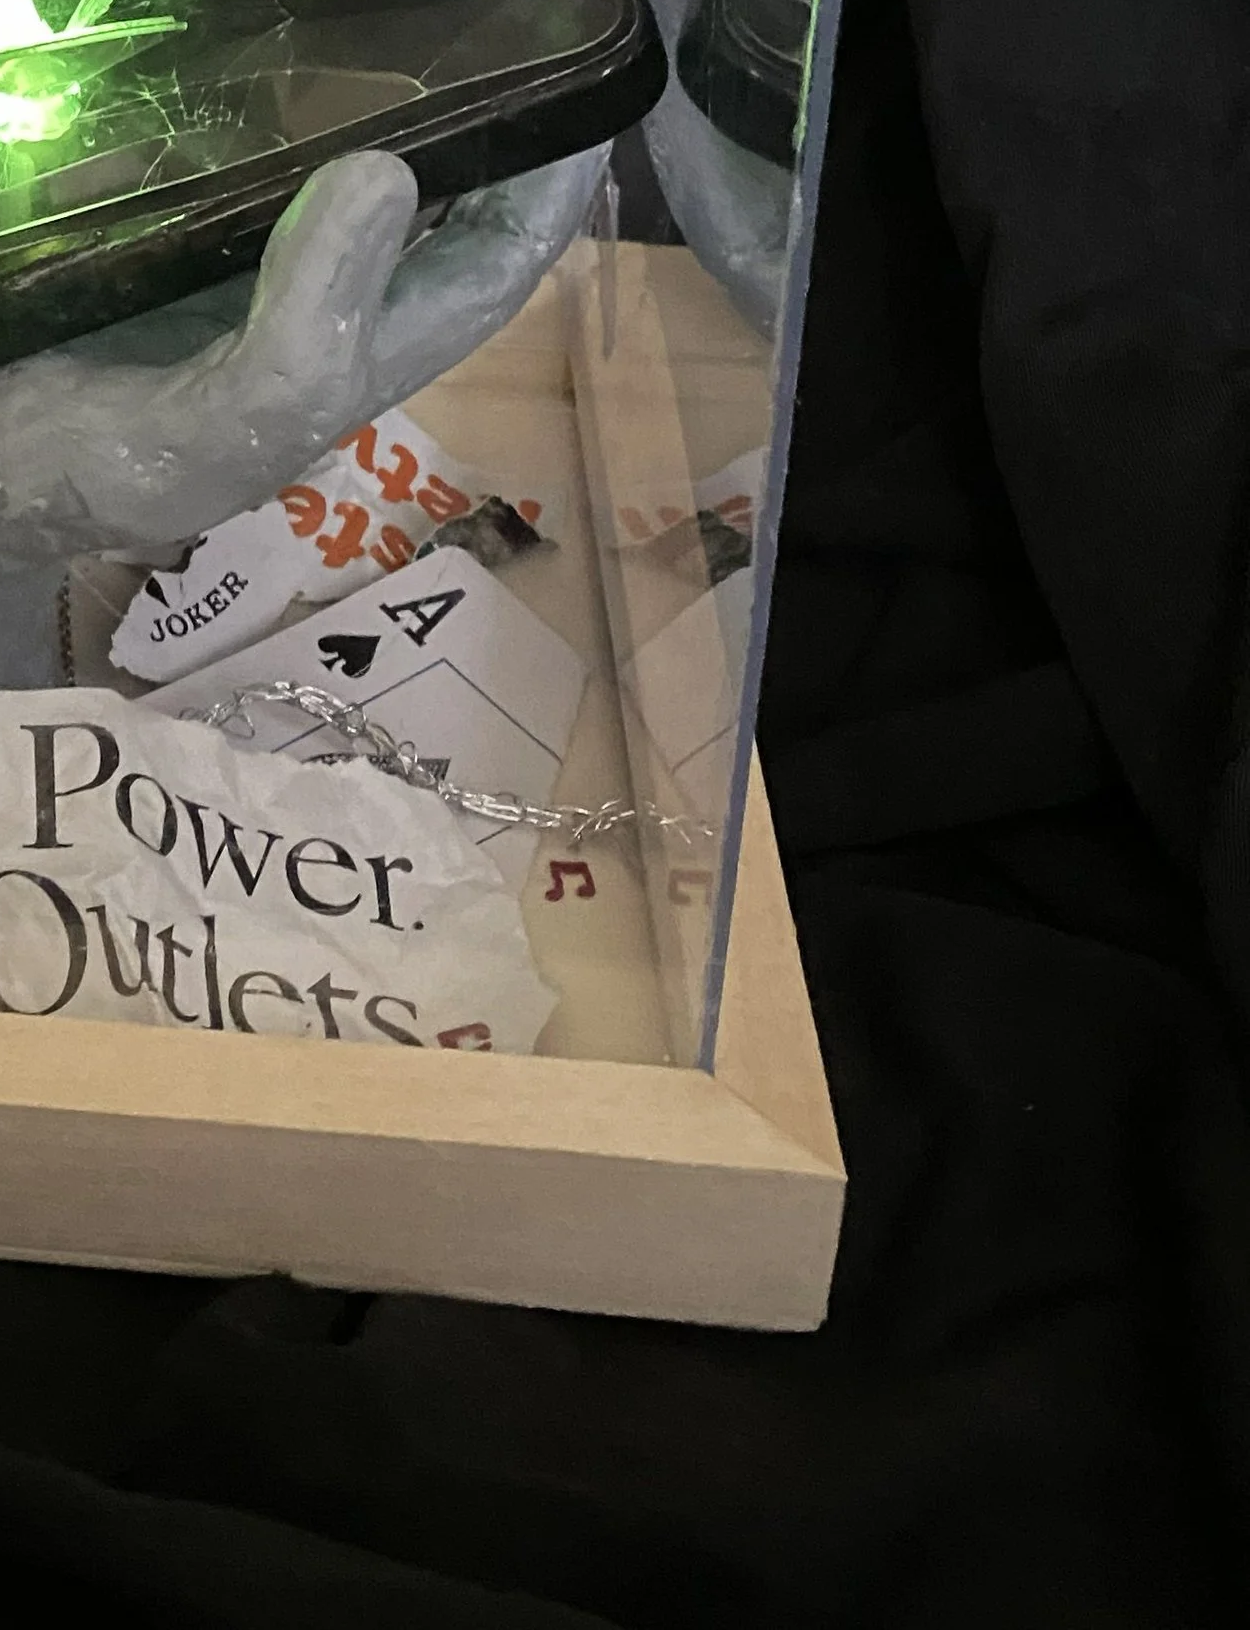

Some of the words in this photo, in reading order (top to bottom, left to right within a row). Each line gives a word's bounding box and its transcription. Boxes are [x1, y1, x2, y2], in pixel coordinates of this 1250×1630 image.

[150, 570, 249, 644] JOKER
[378, 588, 468, 648] A
[18, 723, 427, 932] Power.
